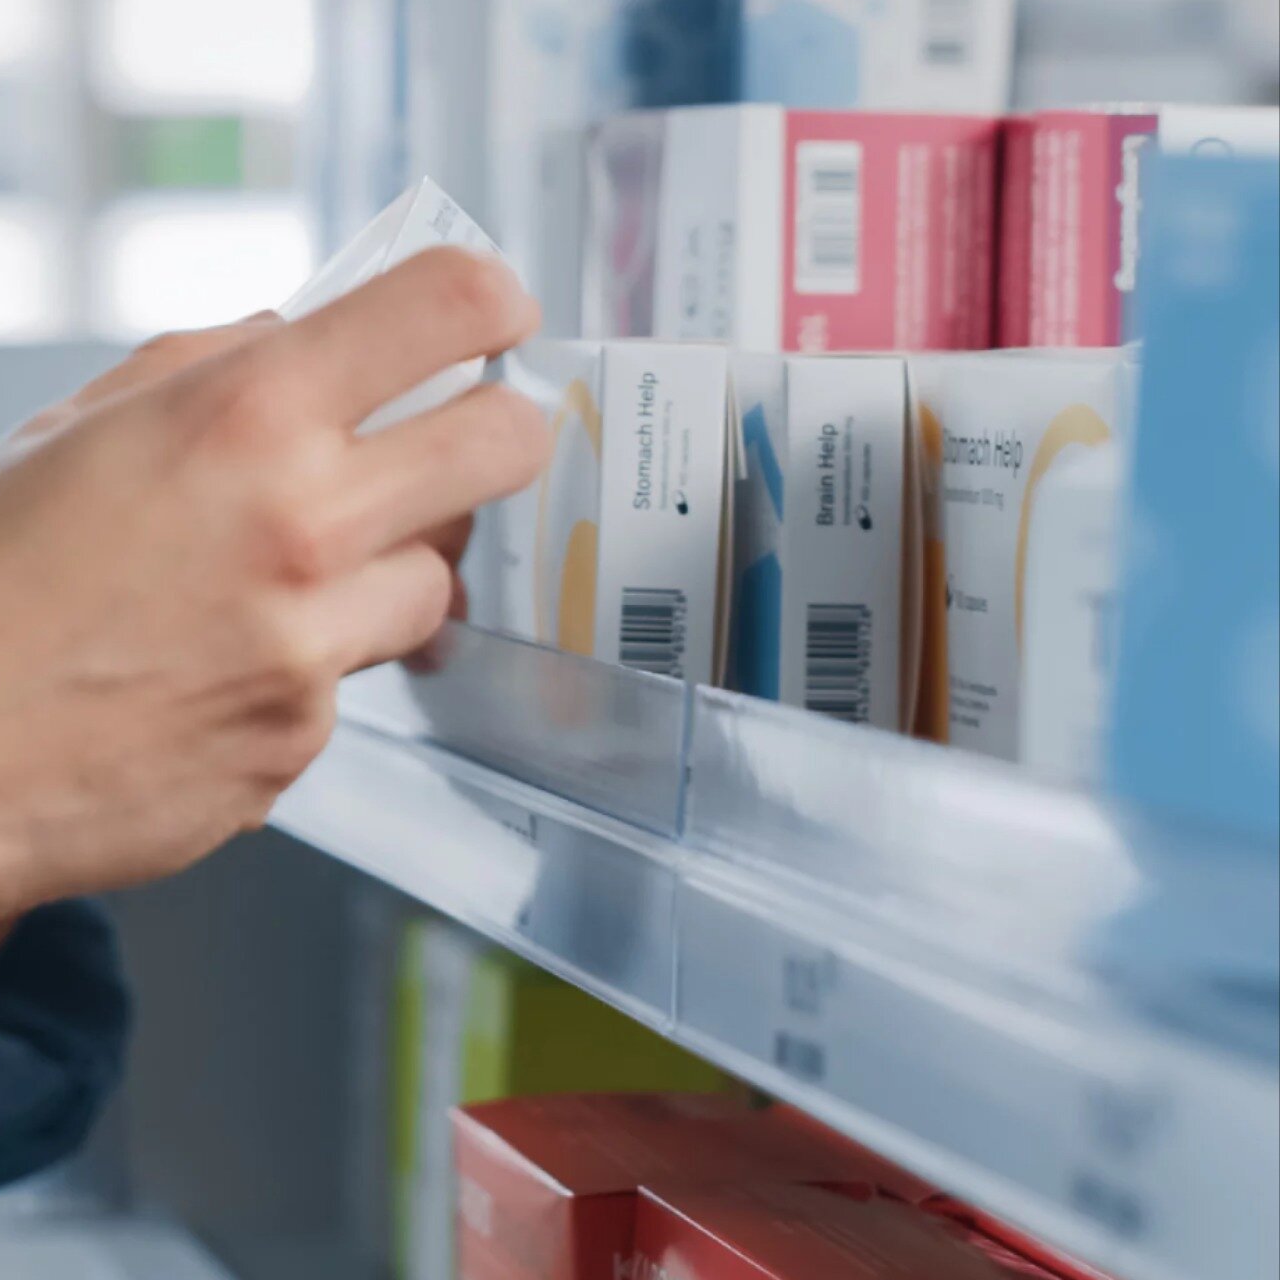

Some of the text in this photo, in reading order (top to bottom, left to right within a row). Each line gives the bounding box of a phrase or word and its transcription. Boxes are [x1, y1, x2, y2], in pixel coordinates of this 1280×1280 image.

[632, 372, 659, 510] Stomach Help
[815, 424, 839, 526] Brain Help
[994, 428, 1024, 479] Help
